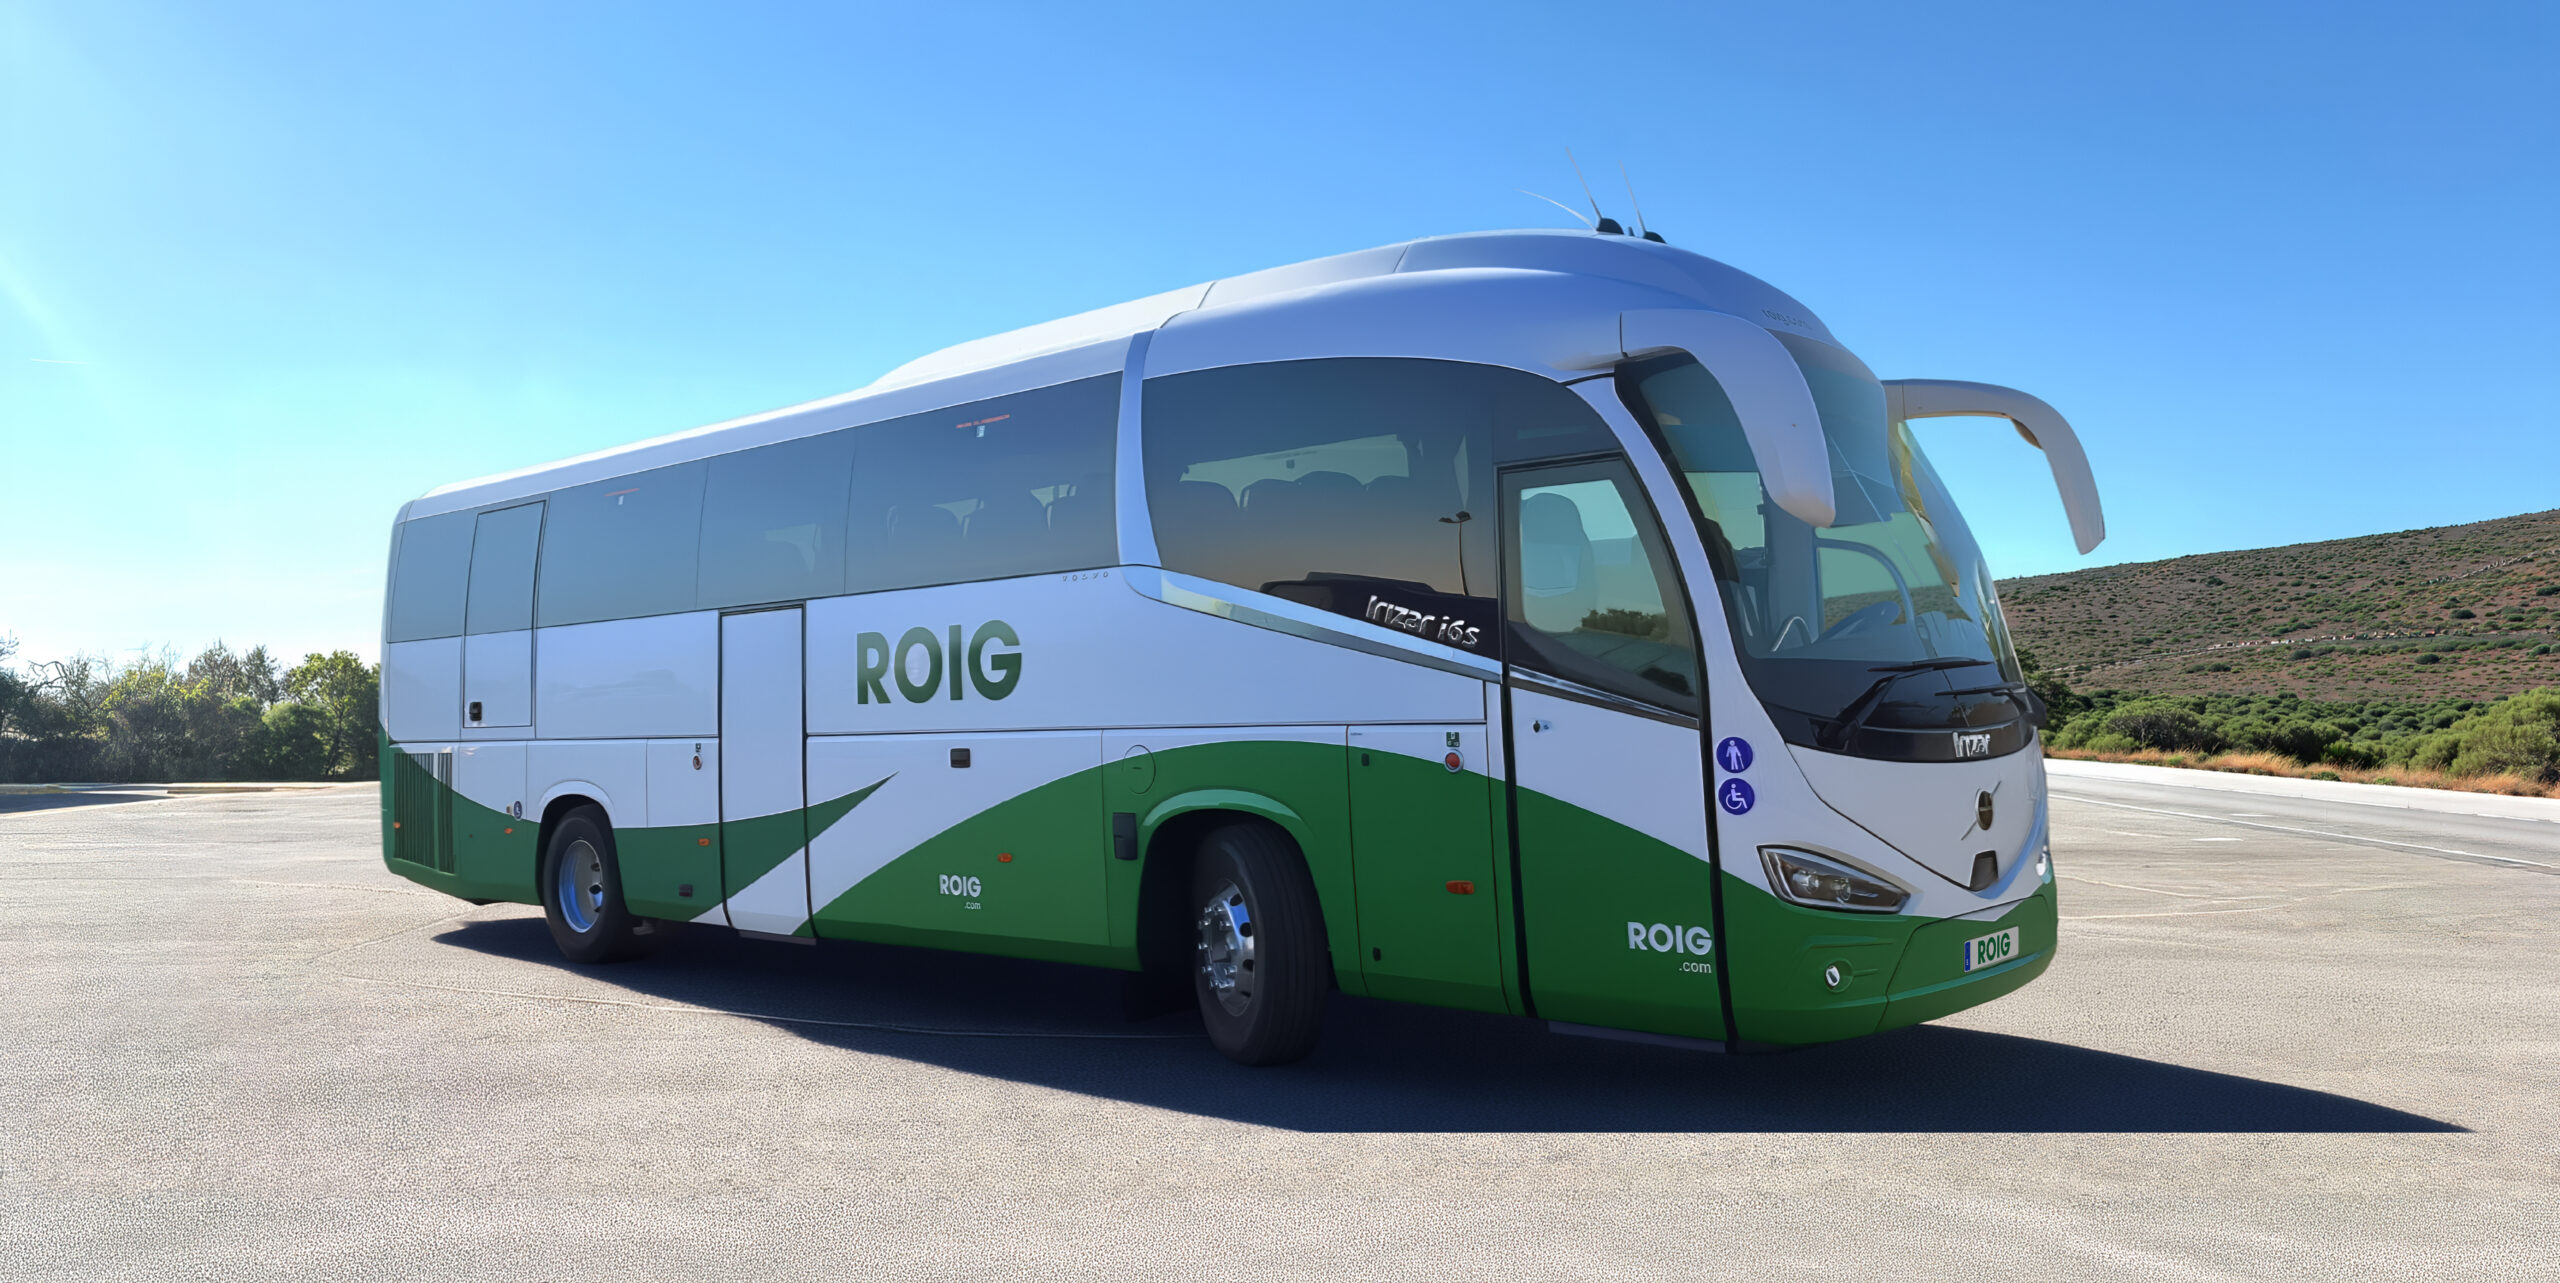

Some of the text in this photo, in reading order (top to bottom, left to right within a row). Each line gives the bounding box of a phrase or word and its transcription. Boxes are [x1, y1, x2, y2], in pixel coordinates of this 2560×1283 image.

[856, 619, 1022, 705] ROIG
[939, 873, 982, 898] ROIG
[1627, 921, 1713, 956] ROIG
[1977, 932, 2011, 965] ROIG
[1679, 961, 1712, 974] .com
